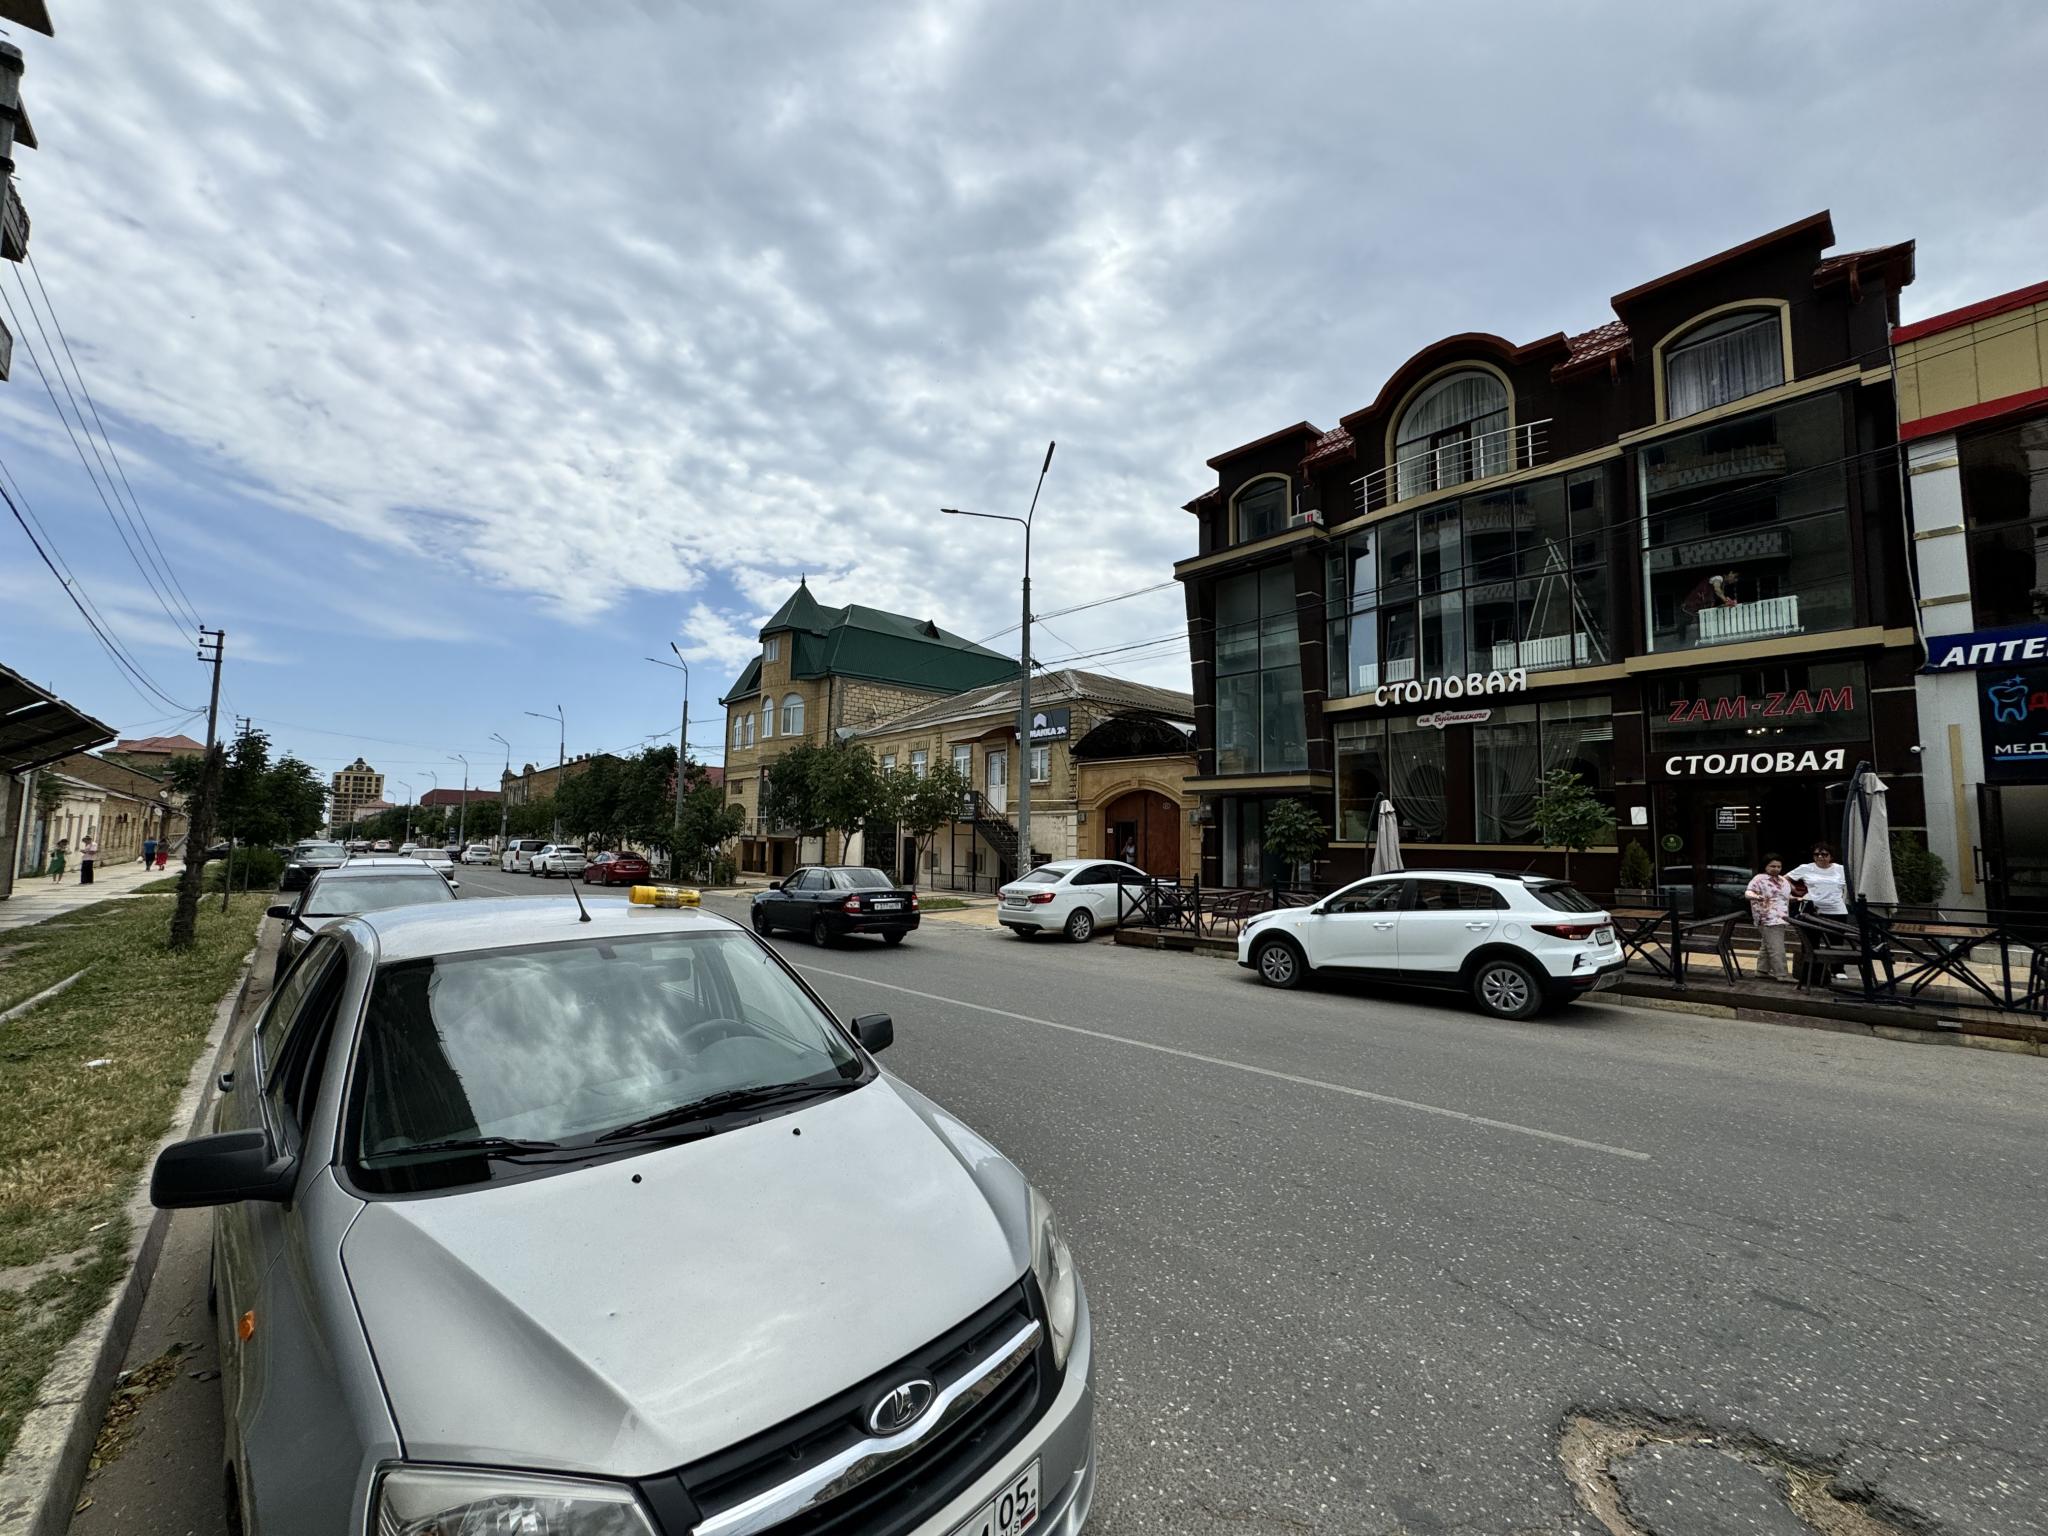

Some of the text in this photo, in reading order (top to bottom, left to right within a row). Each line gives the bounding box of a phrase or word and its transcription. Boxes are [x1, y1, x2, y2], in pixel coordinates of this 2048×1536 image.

[1940, 637, 2048, 668] АПТЕ
[1374, 668, 1527, 707] СТОЛОВАЯ
[1667, 686, 1854, 723] ZAM-ZAM
[1665, 749, 1845, 775] СТОЛОВАЯ
[1000, 1476, 1028, 1531] 05
